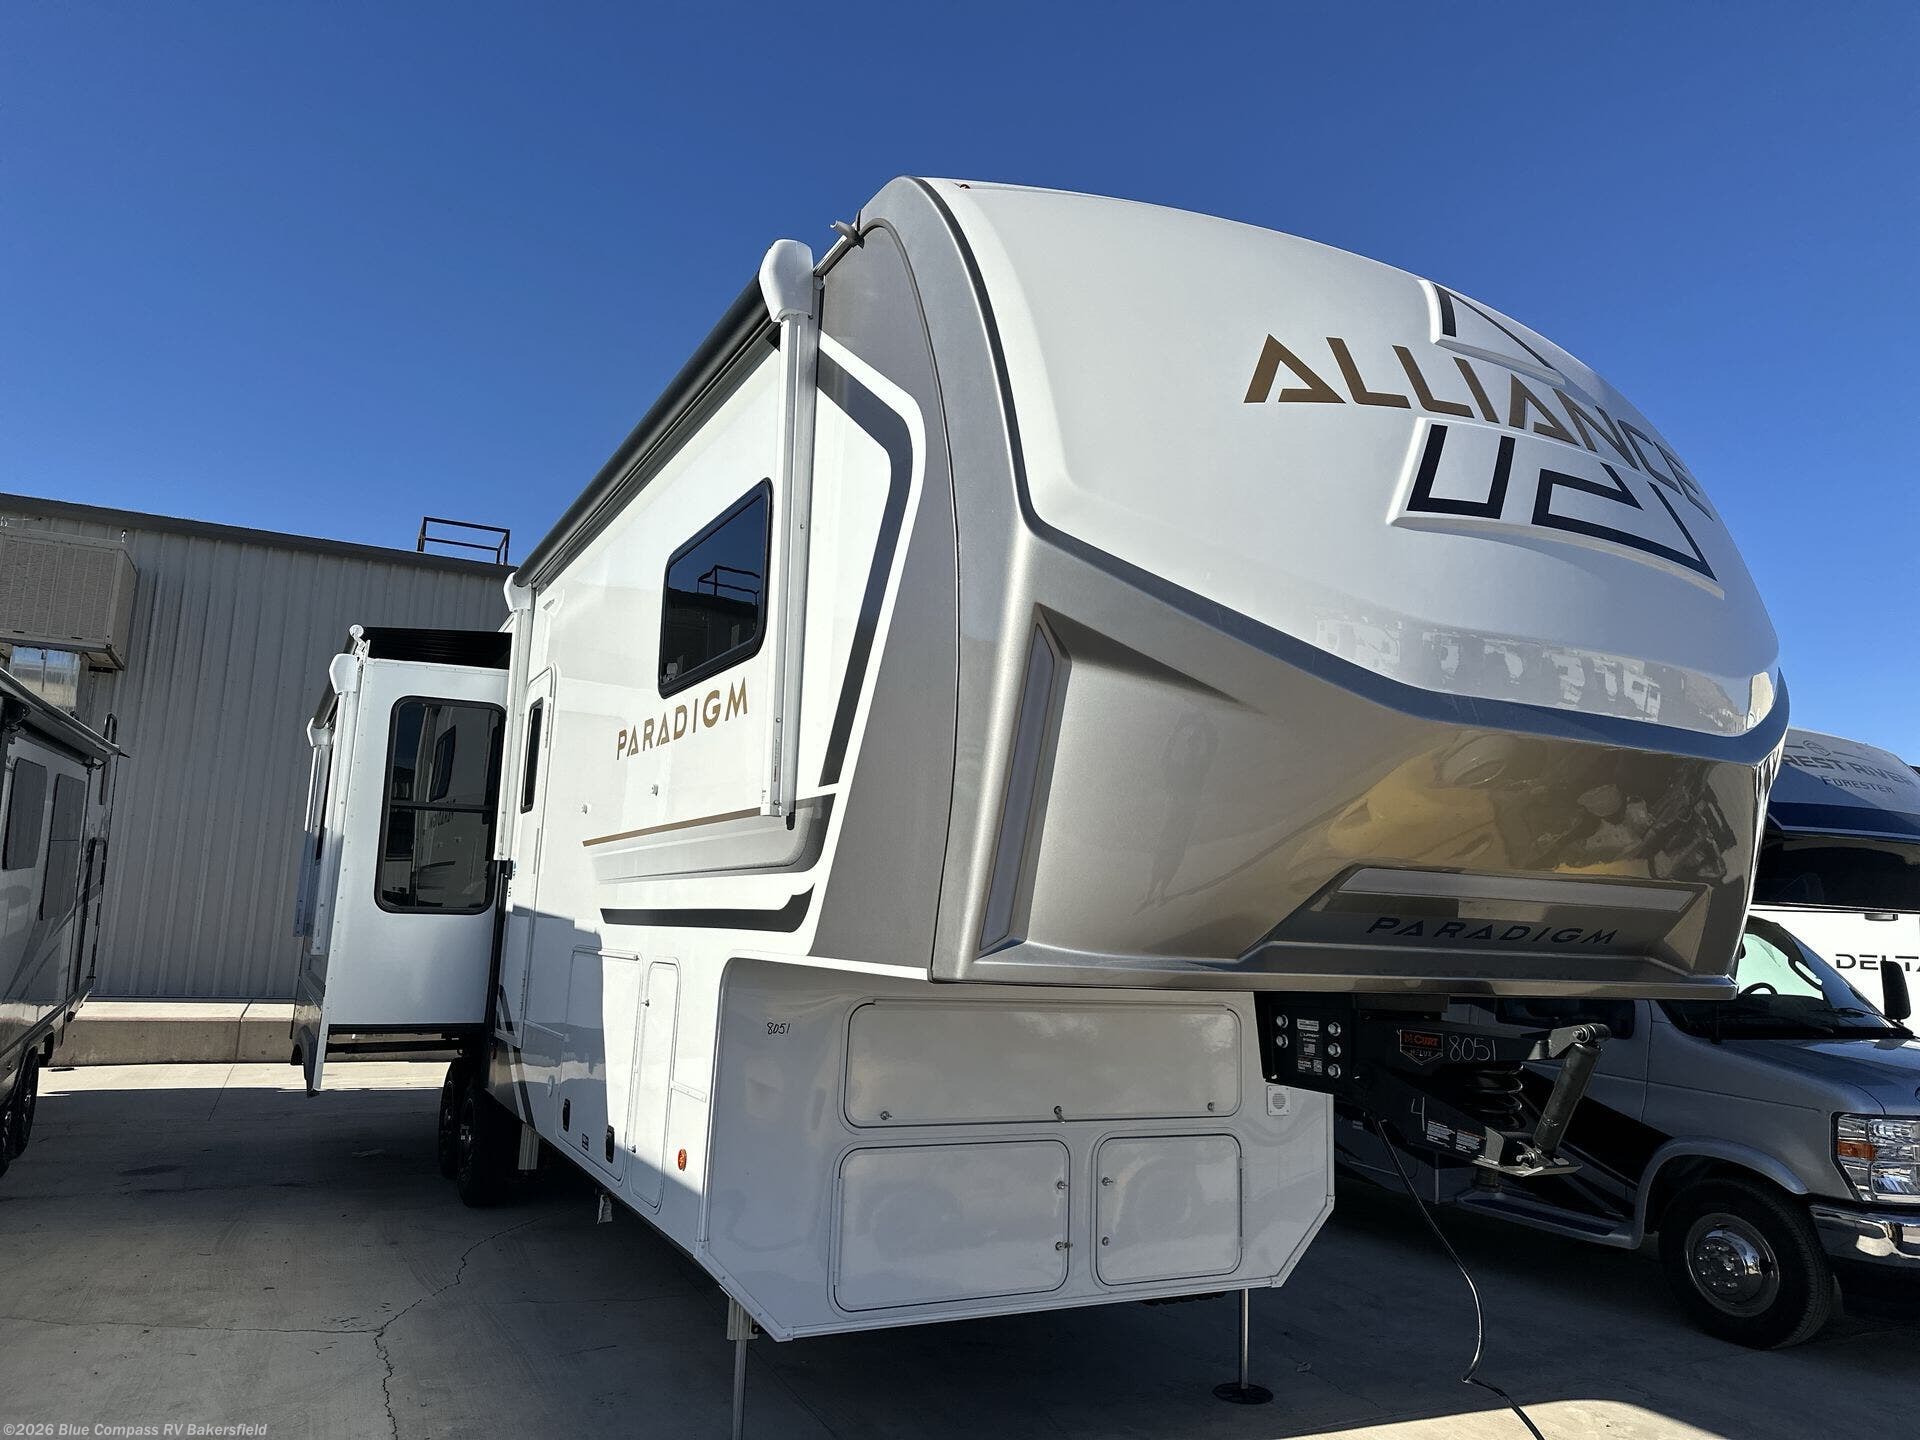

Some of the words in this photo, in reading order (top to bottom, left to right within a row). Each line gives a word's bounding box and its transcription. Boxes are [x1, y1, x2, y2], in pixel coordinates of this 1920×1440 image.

[1243, 333, 1714, 522] ALLIANCE
[616, 676, 748, 761] PARADIGM
[1783, 754, 1846, 771] REST
[1366, 916, 1619, 945] PARADIGM
[1835, 953, 1920, 972] DET
[766, 1021, 791, 1035] 8051
[1448, 1034, 1497, 1062] 8051
